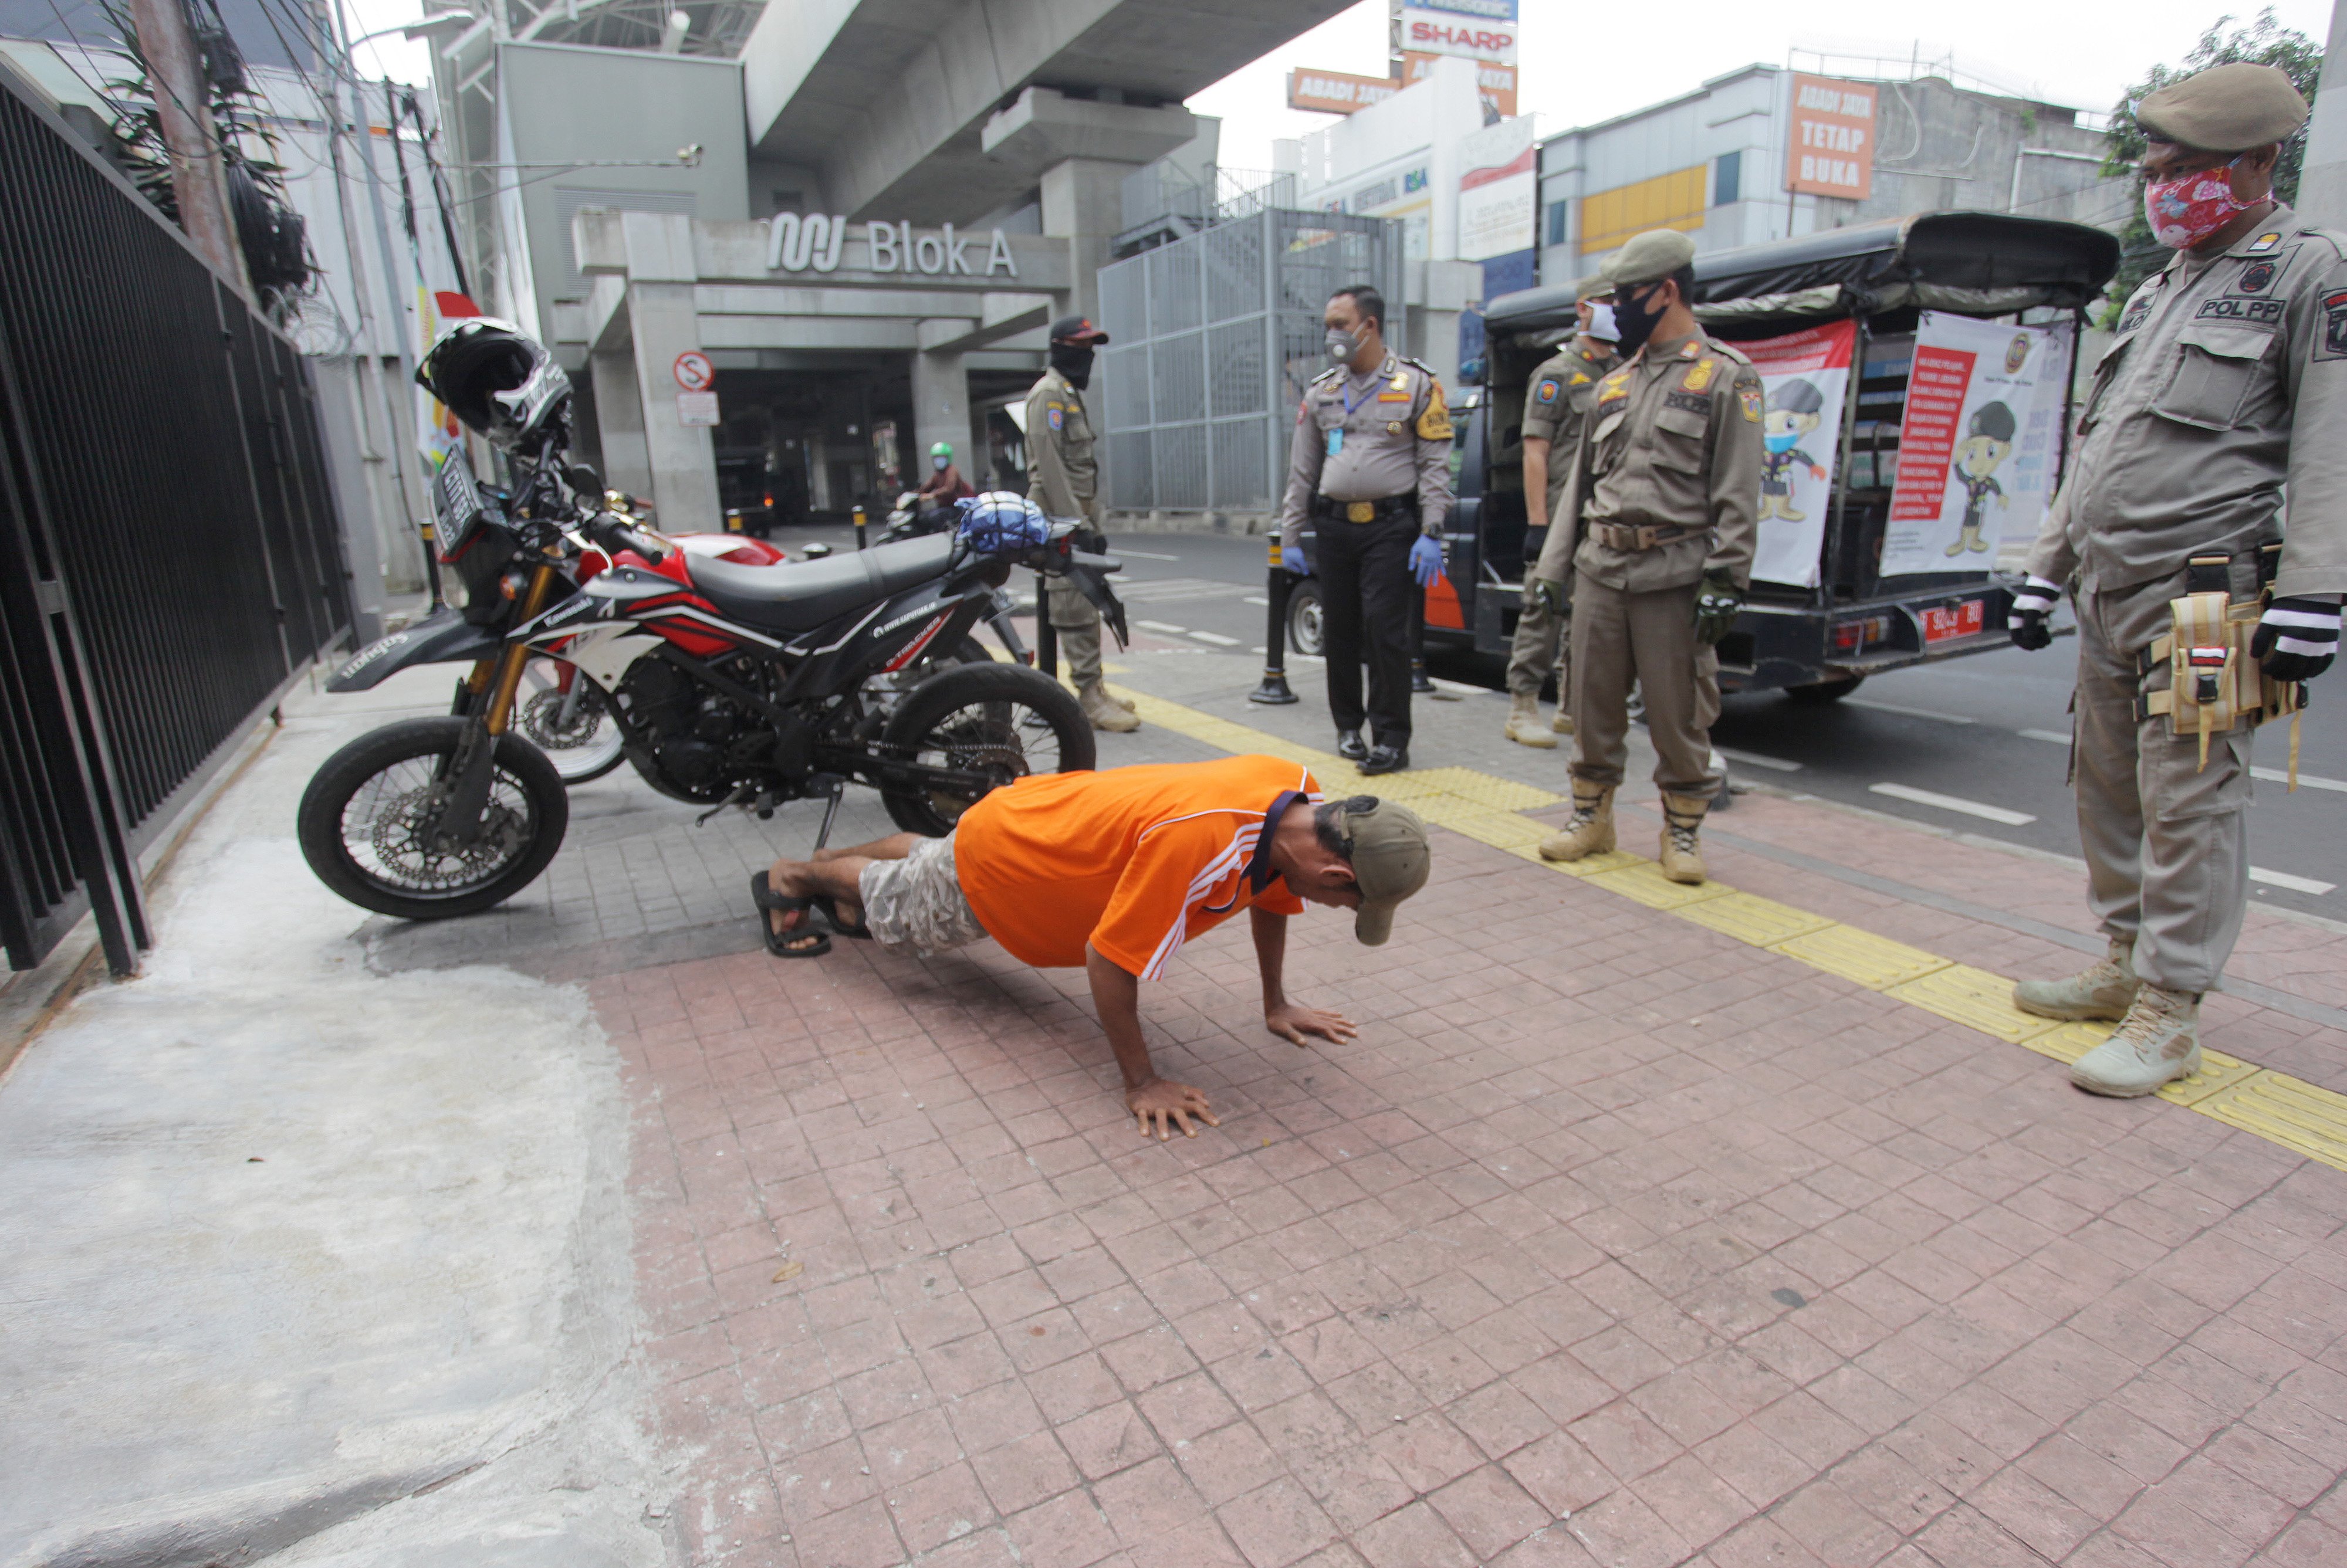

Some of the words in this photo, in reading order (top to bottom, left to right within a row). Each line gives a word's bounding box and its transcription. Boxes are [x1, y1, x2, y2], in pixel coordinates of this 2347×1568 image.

[1412, 22, 1513, 50] SHARP
[1298, 76, 1357, 102] ABADI
[1801, 120, 1865, 153] TETAP
[1800, 155, 1860, 187] BUKA
[867, 219, 972, 275] Blok
[985, 228, 1019, 277] A
[2201, 301, 2244, 316] POL
[2246, 302, 2280, 319] PP
